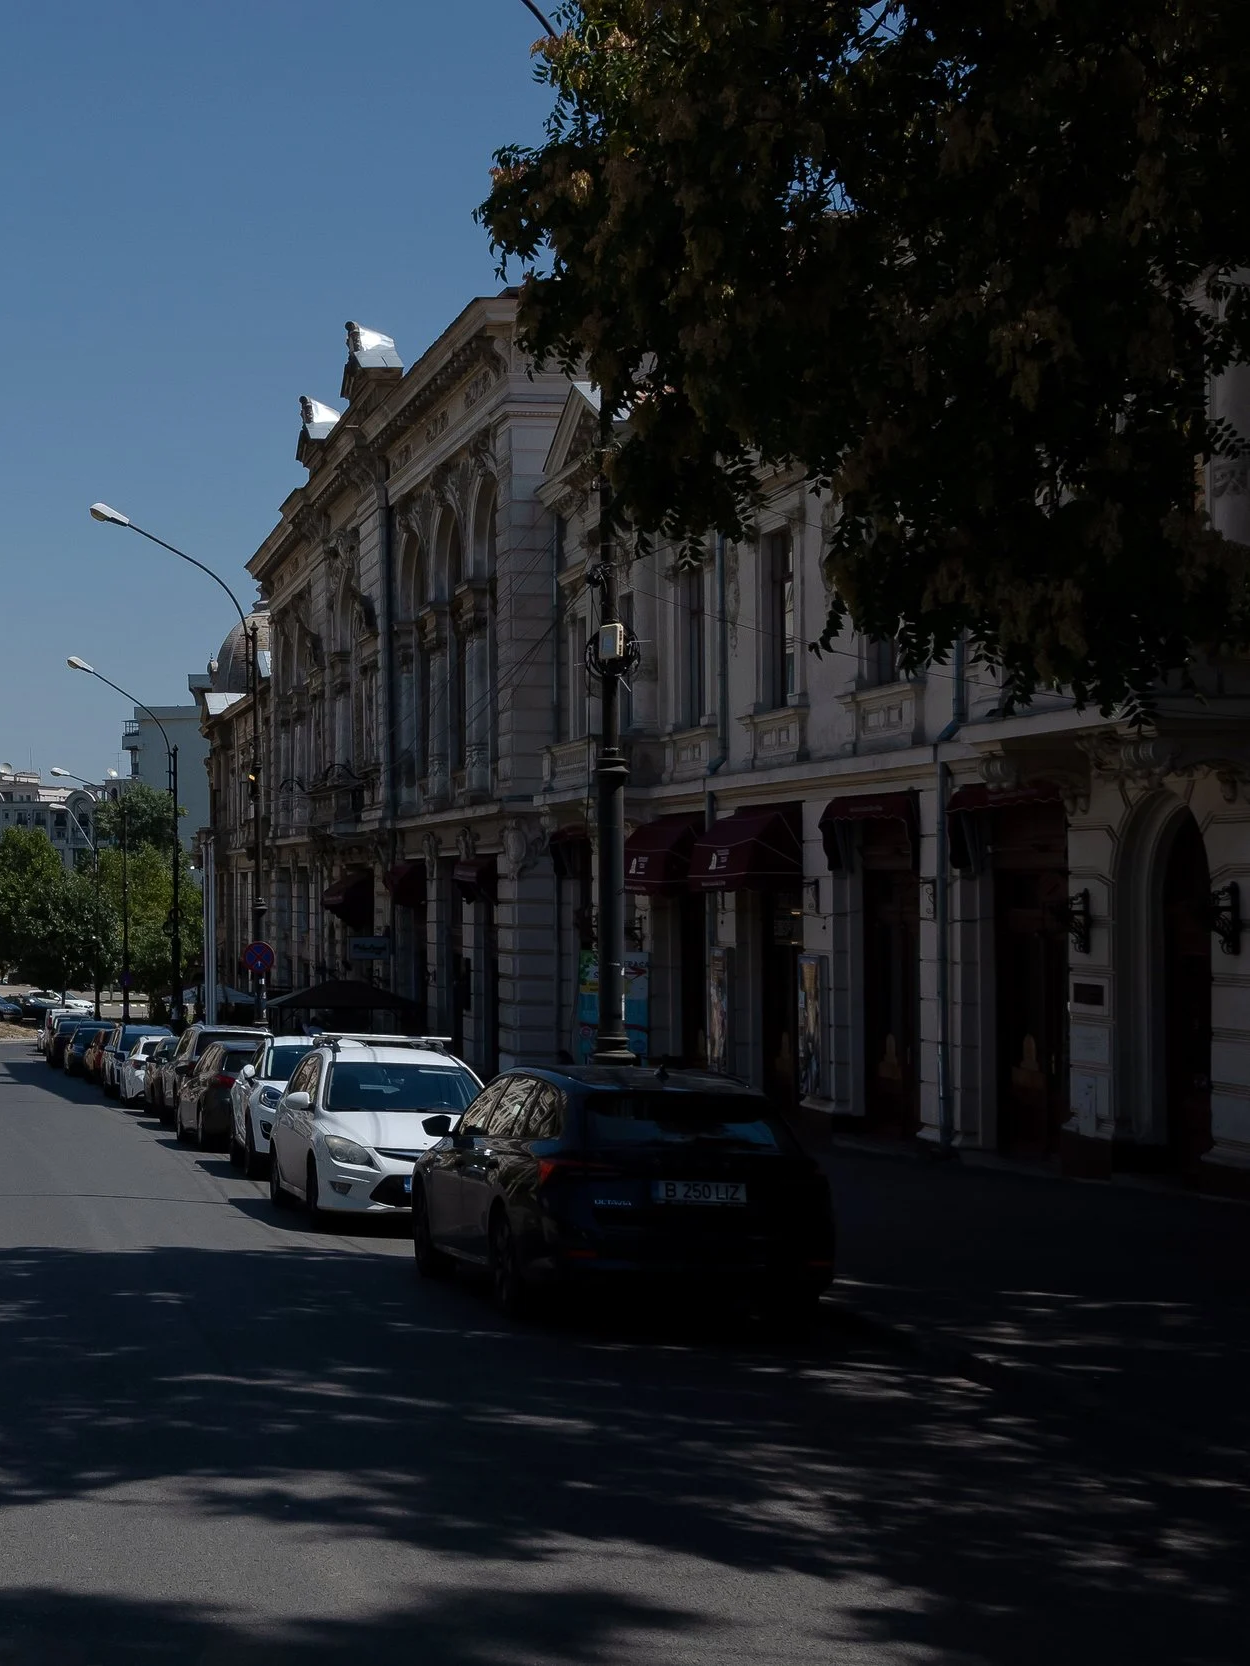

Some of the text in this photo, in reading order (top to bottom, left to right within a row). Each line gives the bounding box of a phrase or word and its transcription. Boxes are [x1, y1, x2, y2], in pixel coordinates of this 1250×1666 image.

[665, 1182, 741, 1200] B 250 LIZ
